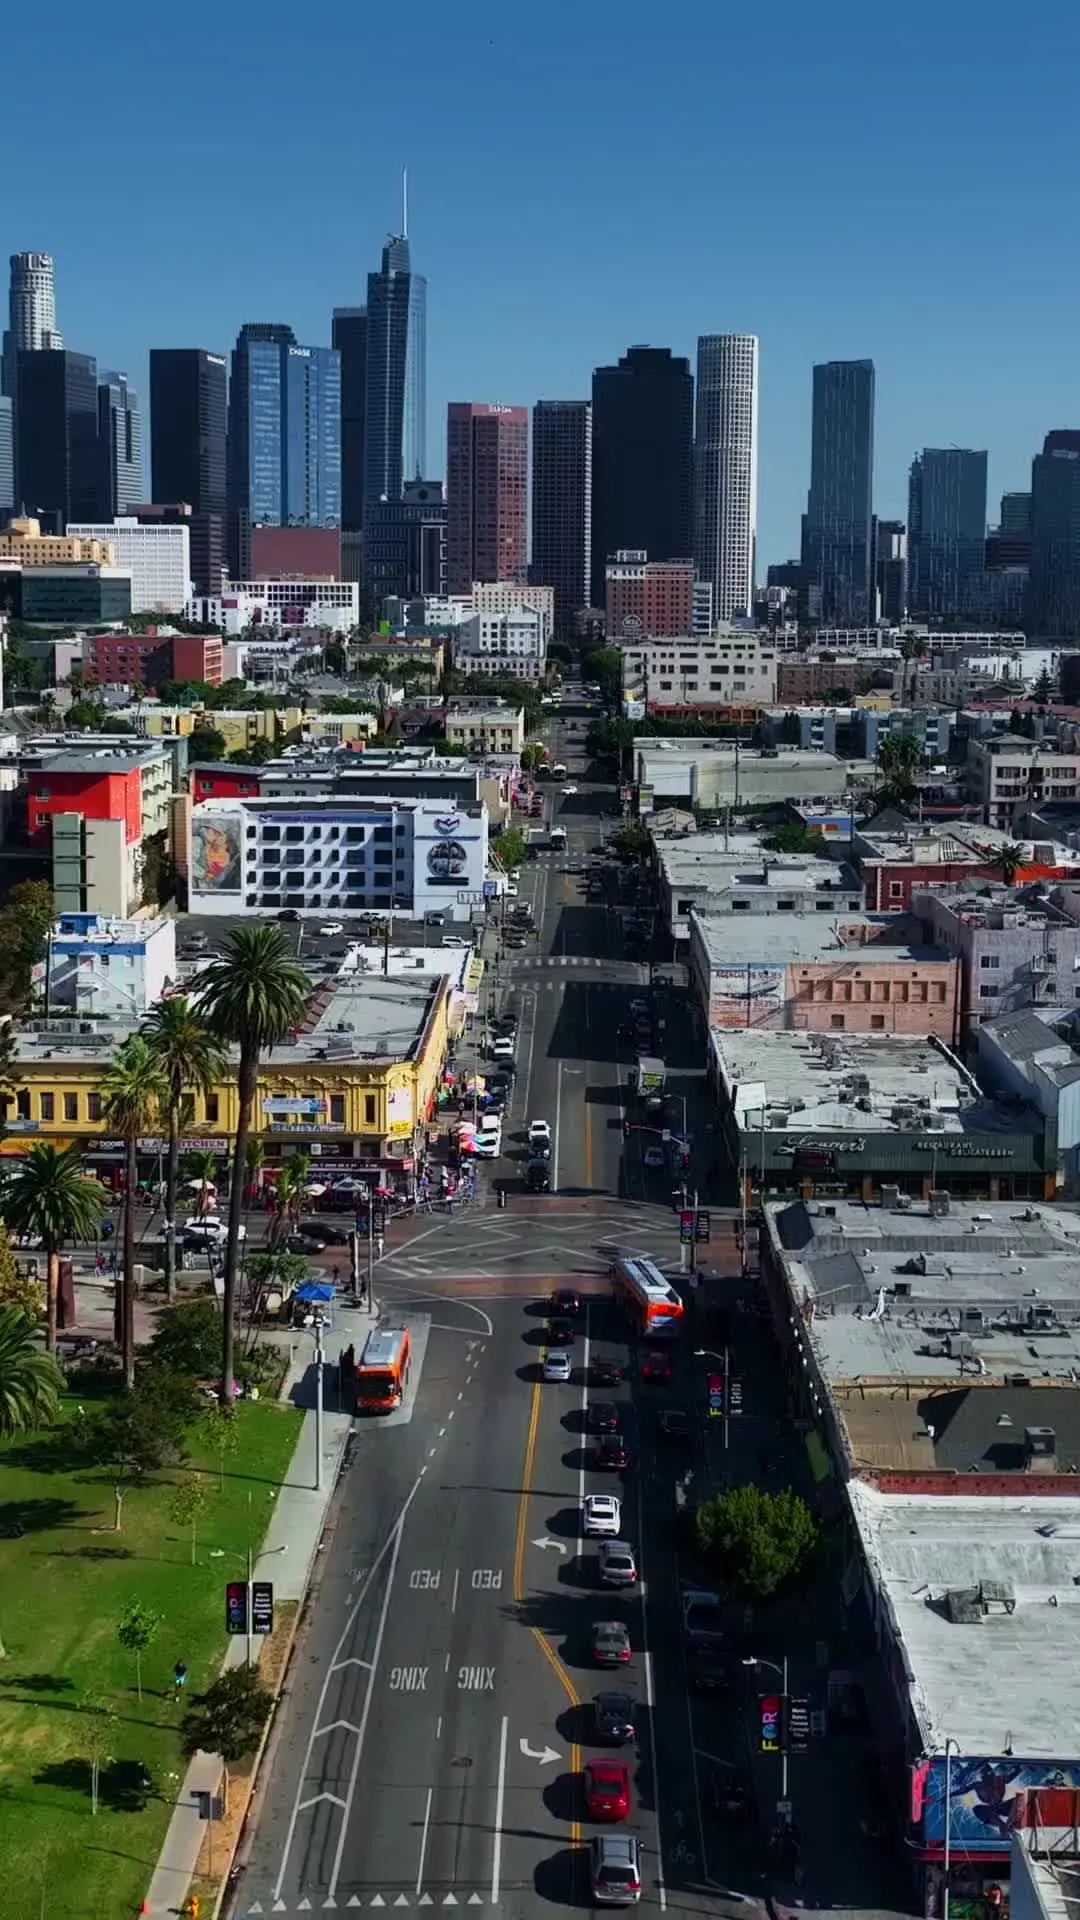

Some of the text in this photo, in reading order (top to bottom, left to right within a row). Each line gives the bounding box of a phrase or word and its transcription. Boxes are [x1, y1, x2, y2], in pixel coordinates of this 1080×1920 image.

[176, 1139, 226, 1149] ITCHEN
[410, 1569, 440, 1589] PED
[471, 1569, 502, 1589] PED
[390, 1667, 428, 1690] XING
[457, 1666, 495, 1690] XING
